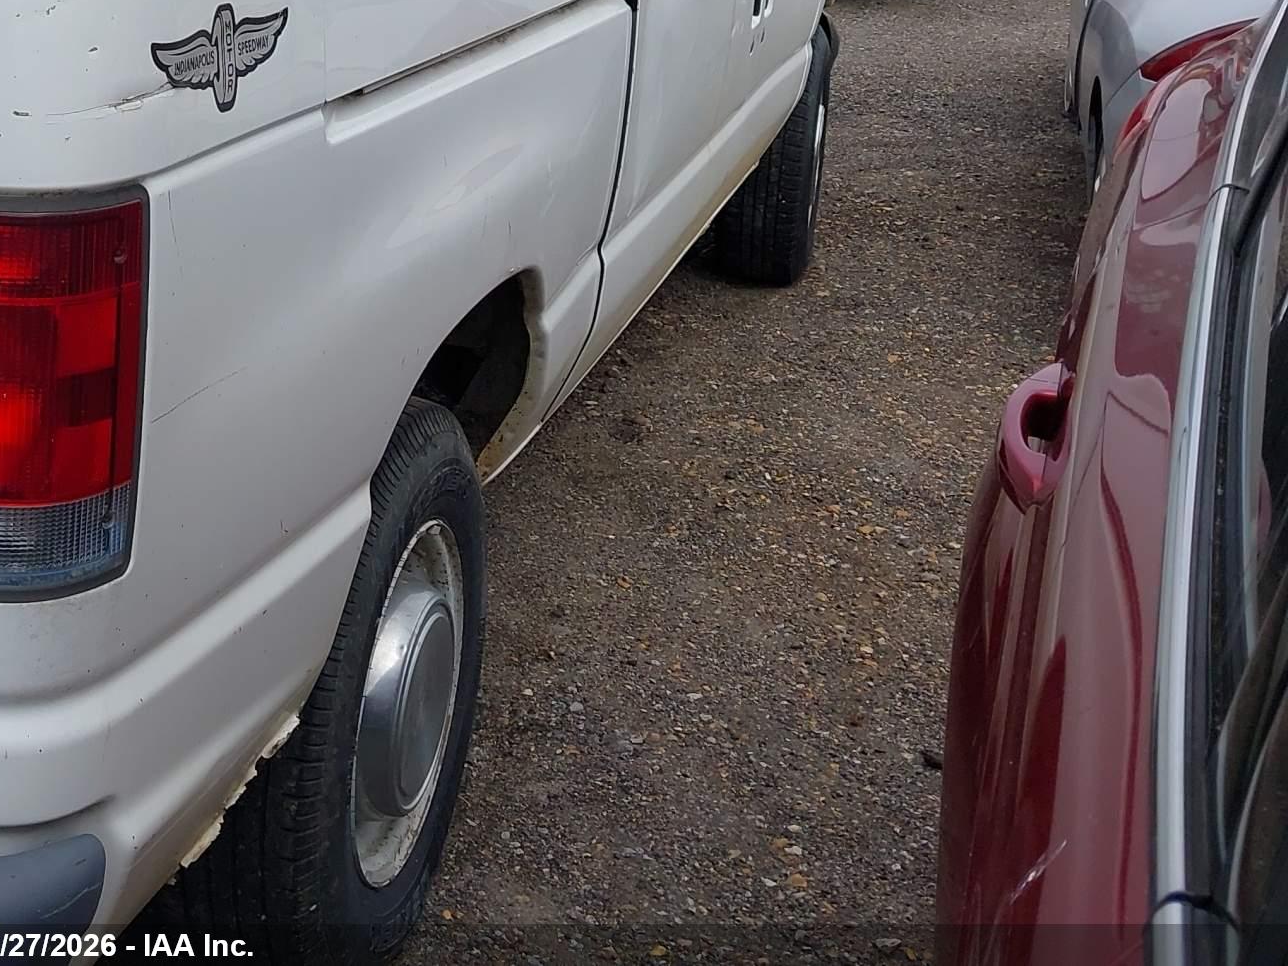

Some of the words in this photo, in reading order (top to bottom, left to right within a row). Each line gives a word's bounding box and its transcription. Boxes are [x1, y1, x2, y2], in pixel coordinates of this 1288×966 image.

[174, 50, 215, 76] INDIANAPOLIS
[224, 20, 234, 94] MOTOR
[237, 34, 270, 56] SPEEDWAY
